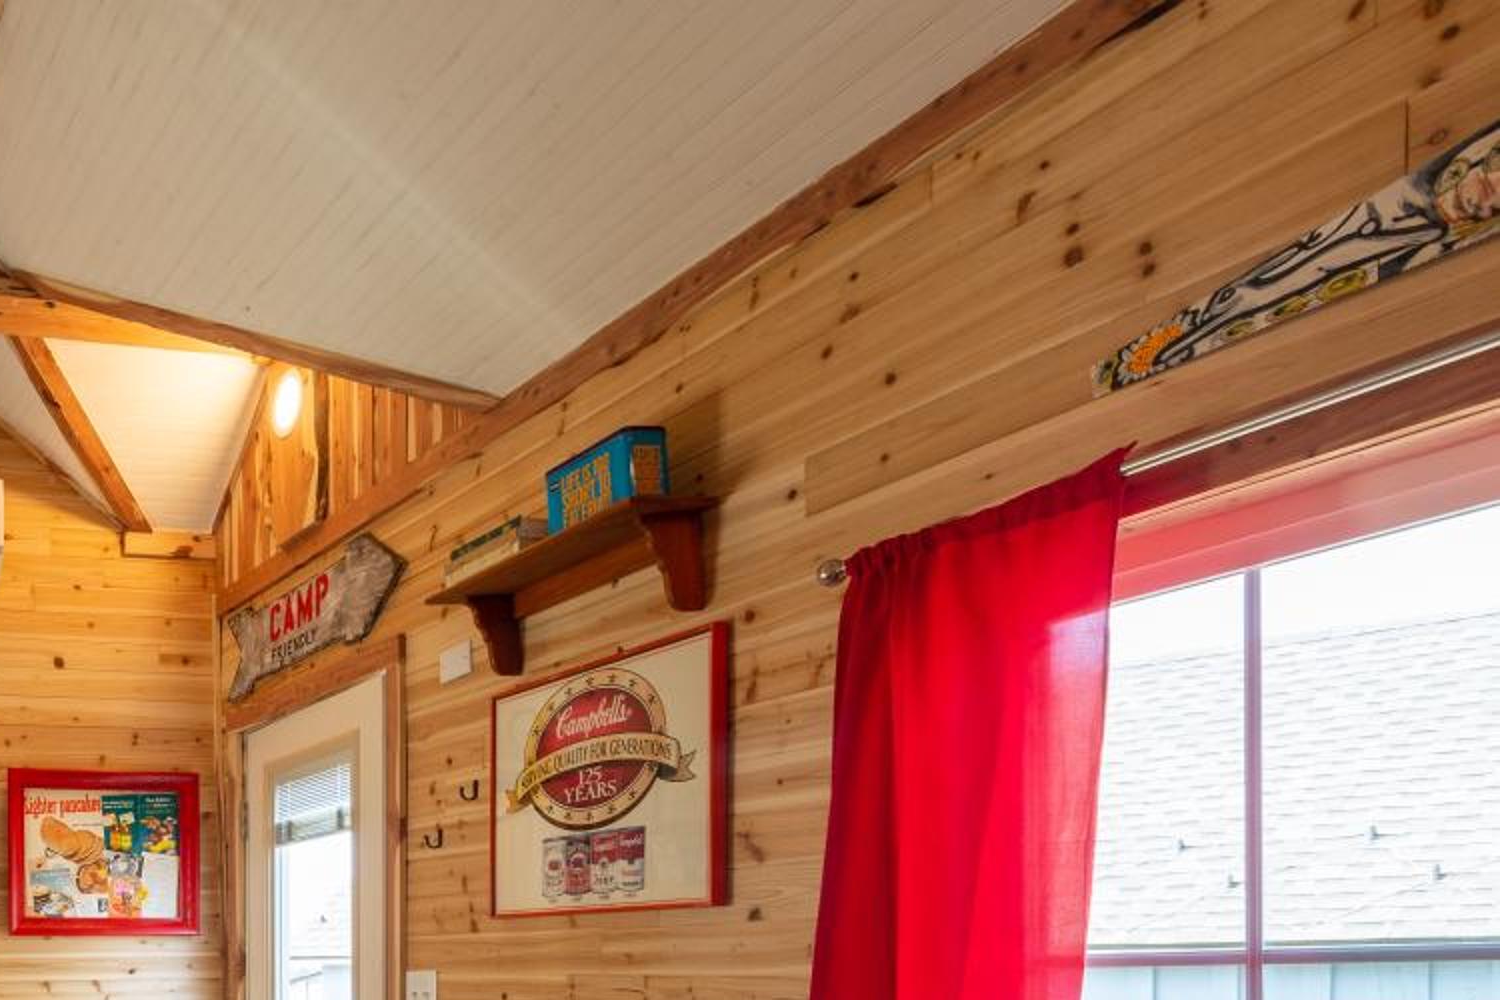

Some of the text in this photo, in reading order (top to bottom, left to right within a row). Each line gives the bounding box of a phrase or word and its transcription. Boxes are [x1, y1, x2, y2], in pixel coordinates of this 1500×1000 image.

[269, 574, 329, 641] CAMP
[271, 629, 317, 662] FRIENDLY
[578, 765, 602, 786] 125
[563, 780, 618, 804] YEARS
